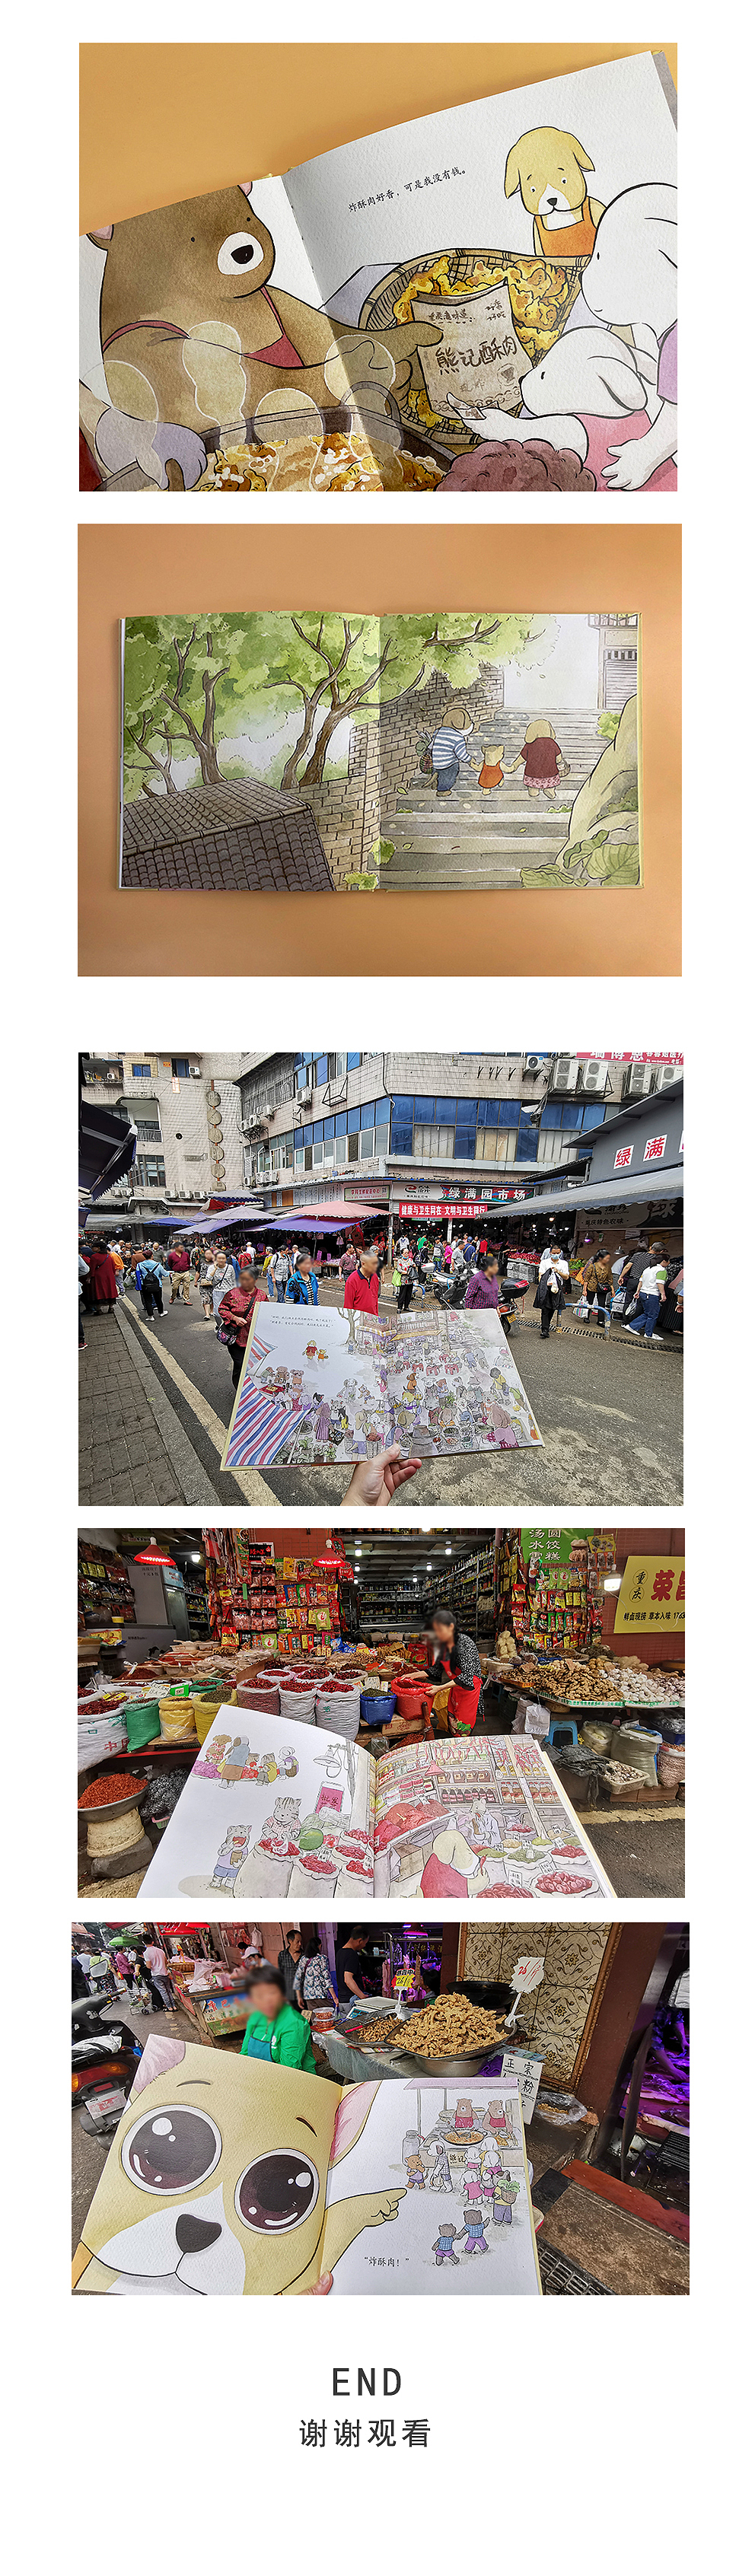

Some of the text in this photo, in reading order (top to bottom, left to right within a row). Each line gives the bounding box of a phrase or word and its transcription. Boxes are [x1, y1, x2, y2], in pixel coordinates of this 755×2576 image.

[348, 166, 466, 213] 炸酥肉好香，可是我没有钱。
[435, 335, 518, 375] 熊记酥肉
[615, 1137, 683, 1167] 绿满
[448, 1186, 526, 1201] 绿满园市场
[401, 1205, 486, 1215] 健康与卫生同在 文明与卫生同行
[529, 1529, 561, 1538] 汤圆
[528, 1540, 561, 1549] 水饺
[632, 1571, 646, 1600] 重庆
[648, 1612, 671, 1620] 草本入味
